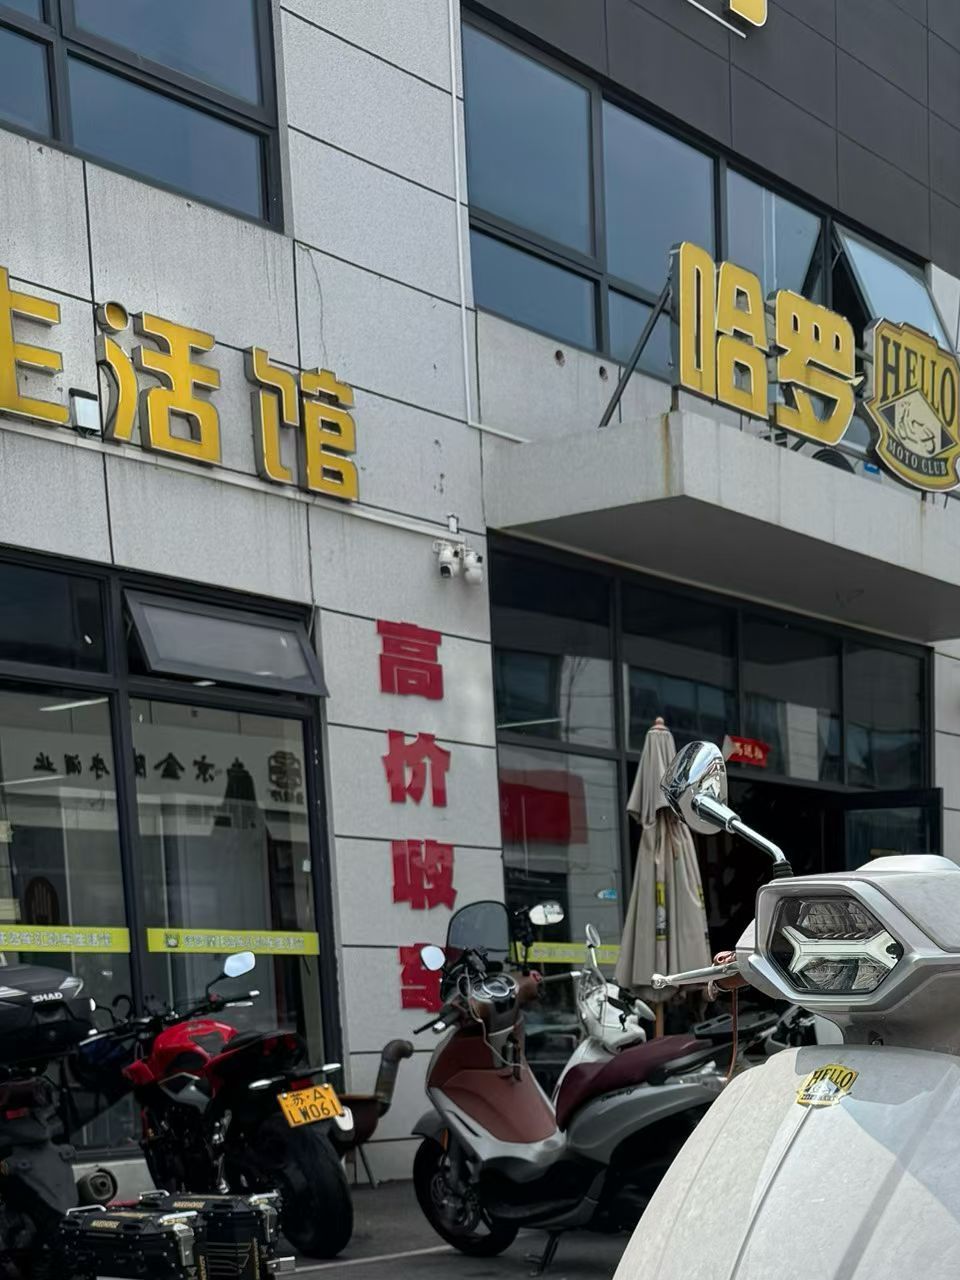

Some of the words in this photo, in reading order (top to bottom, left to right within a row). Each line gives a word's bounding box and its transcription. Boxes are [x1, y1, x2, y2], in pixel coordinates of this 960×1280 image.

[677, 241, 865, 447] 哈罗
[880, 335, 957, 427] HELLO
[888, 437, 919, 469] MOTO
[921, 458, 948, 477] CLUB
[31, 991, 63, 1004] SHAD
[806, 1068, 854, 1088] HELLO
